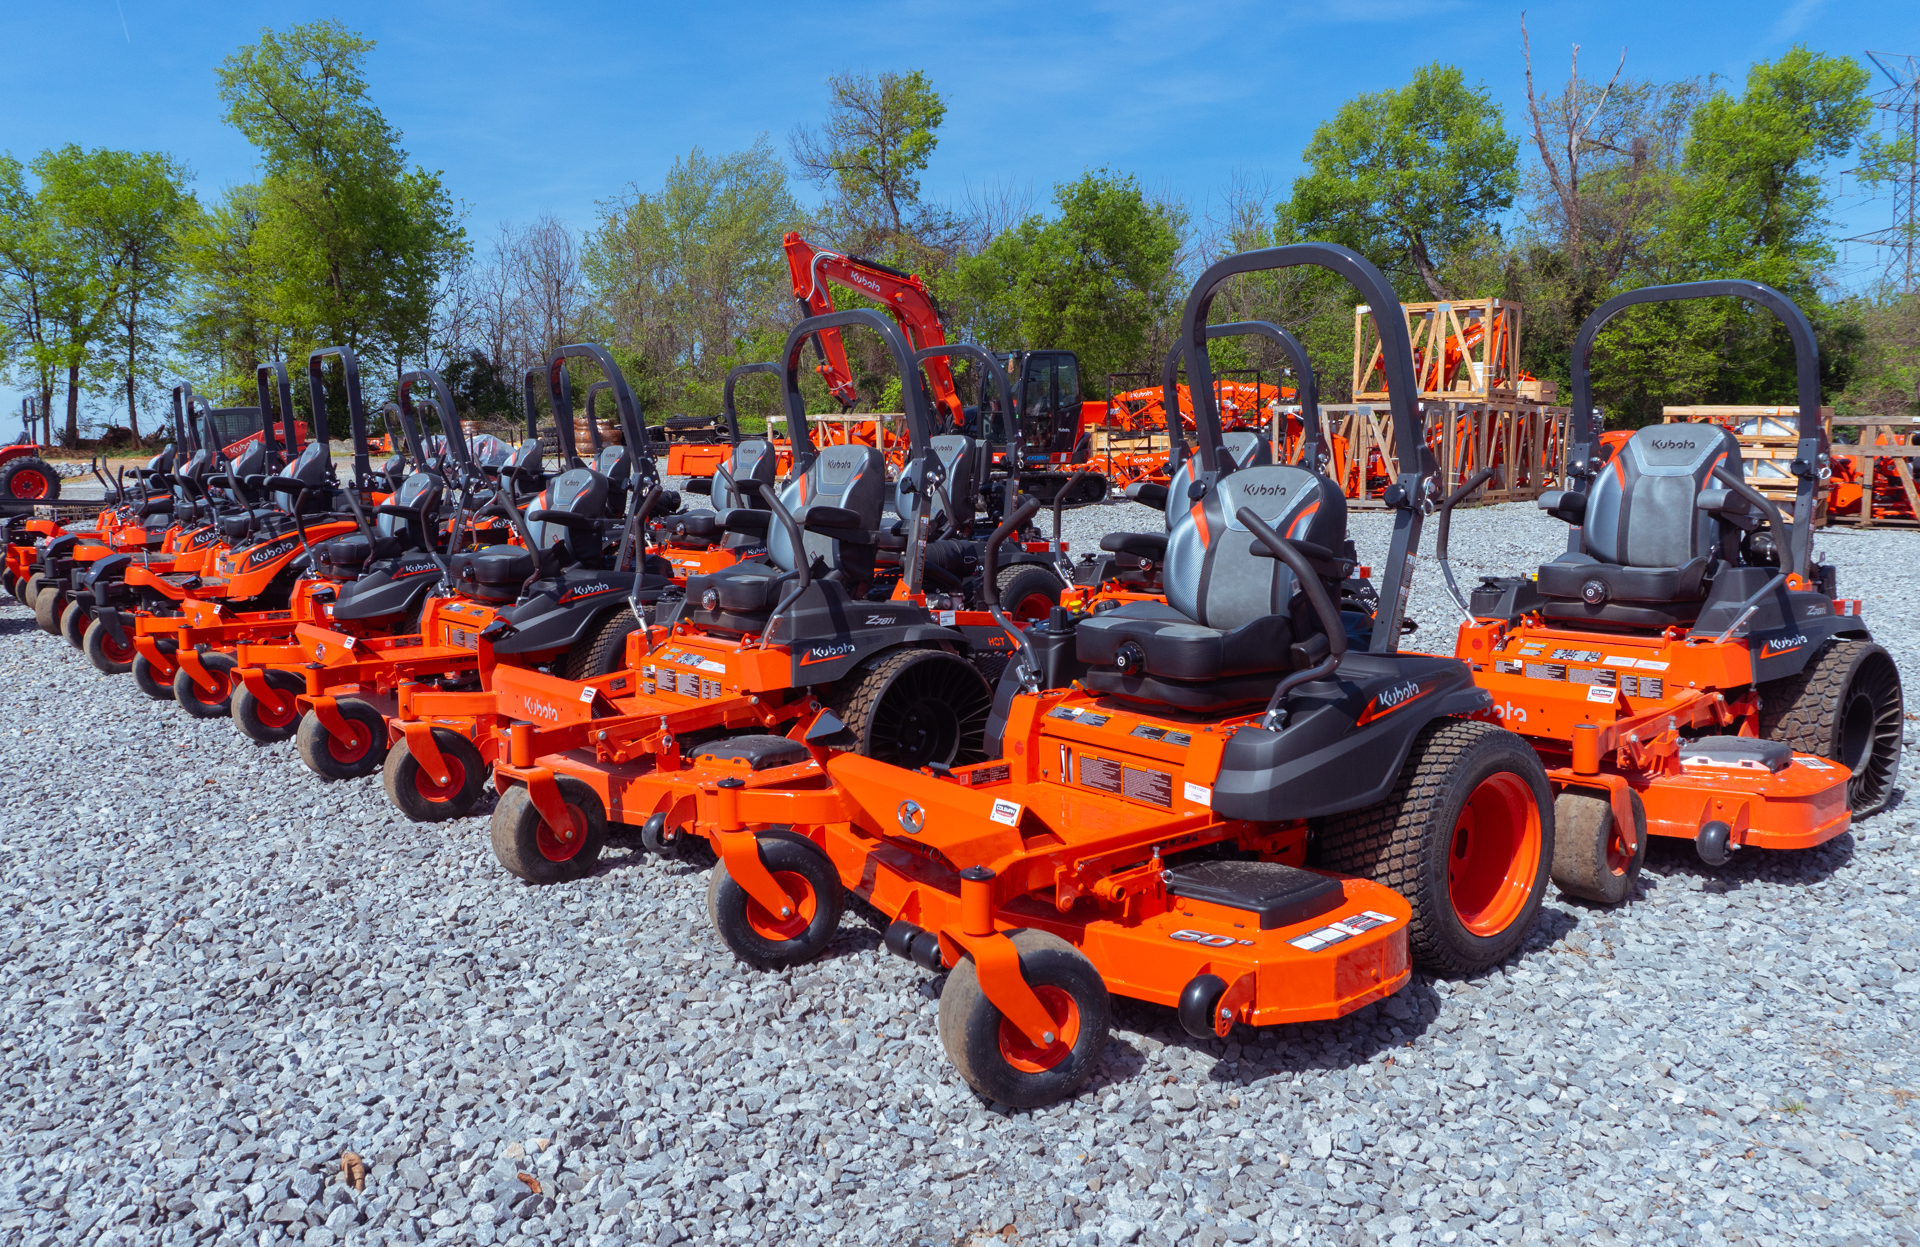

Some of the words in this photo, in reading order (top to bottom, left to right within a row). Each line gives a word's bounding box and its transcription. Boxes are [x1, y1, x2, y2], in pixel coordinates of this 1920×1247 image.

[851, 271, 880, 292] Kubota
[1651, 440, 1696, 449] Kubota
[828, 460, 851, 469] Kubota
[1244, 484, 1287, 496] Kubota
[493, 518, 511, 528] Kub
[195, 532, 216, 543] Kub
[251, 542, 294, 562] Kubota
[405, 562, 437, 572] Kubota
[573, 582, 609, 595] Kubota
[987, 637, 1005, 646] HOT
[1770, 634, 1808, 650] Kubota
[812, 643, 856, 657] Kubota
[1379, 681, 1420, 706] Kubota
[524, 696, 558, 722] Kubota
[1482, 701, 1527, 722] ota
